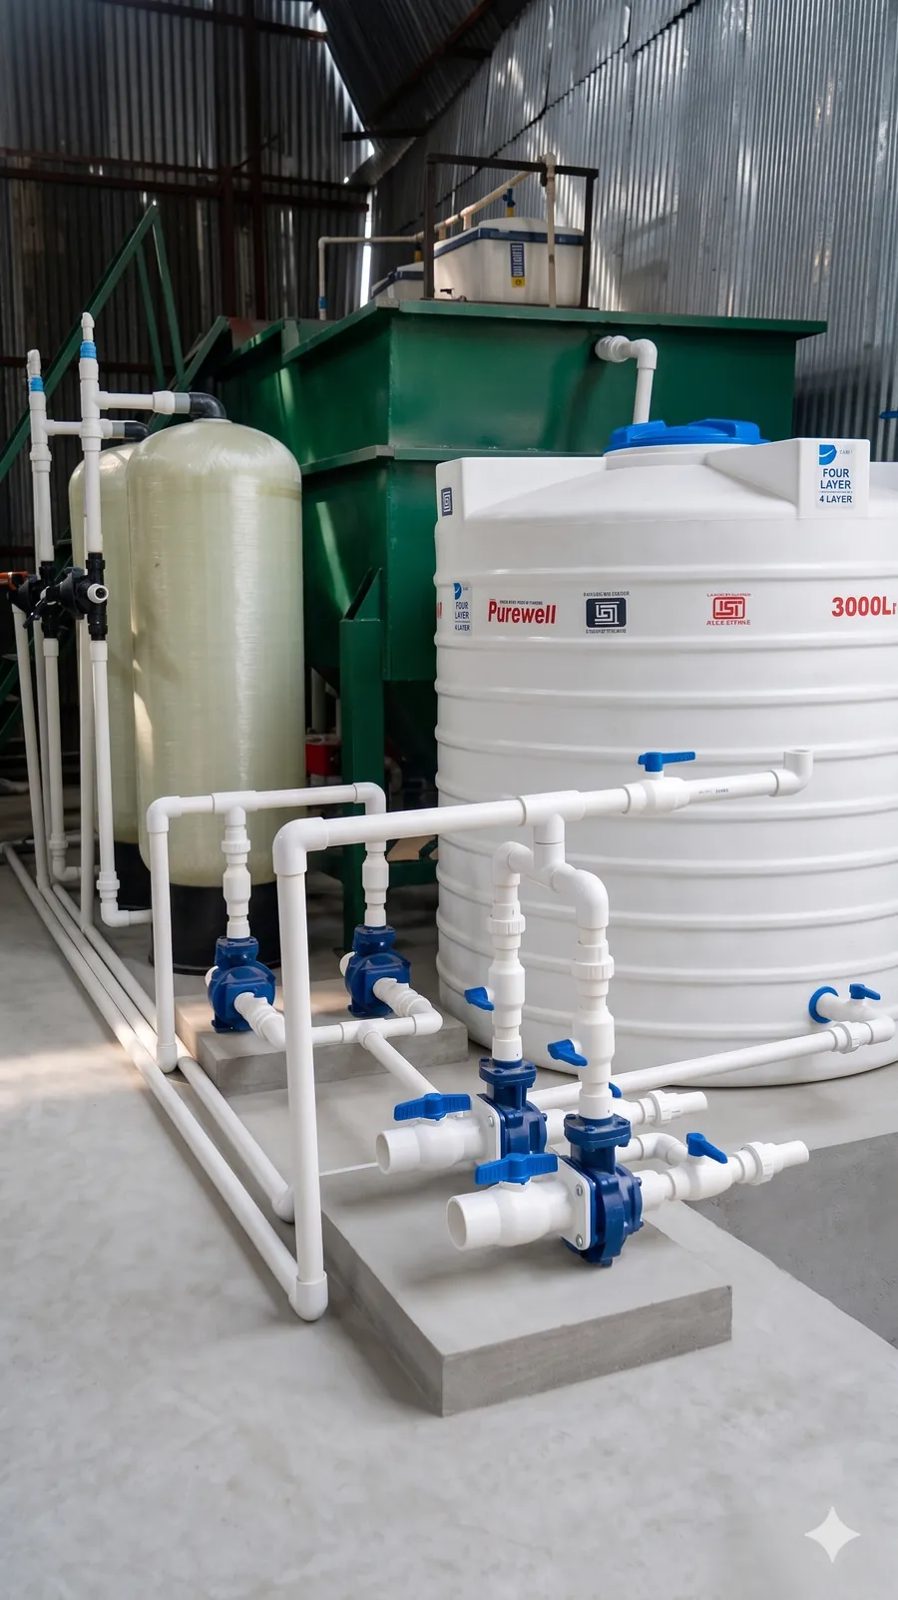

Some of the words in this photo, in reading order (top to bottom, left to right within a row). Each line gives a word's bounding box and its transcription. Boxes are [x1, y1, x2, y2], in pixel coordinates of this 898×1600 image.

[823, 468, 849, 478] FOUR
[820, 479, 851, 489] LAYER
[819, 495, 825, 503] 4
[826, 495, 853, 503] LAYER
[455, 601, 469, 610] FOUR
[454, 611, 470, 620] LAYER
[488, 600, 556, 624] Purewell
